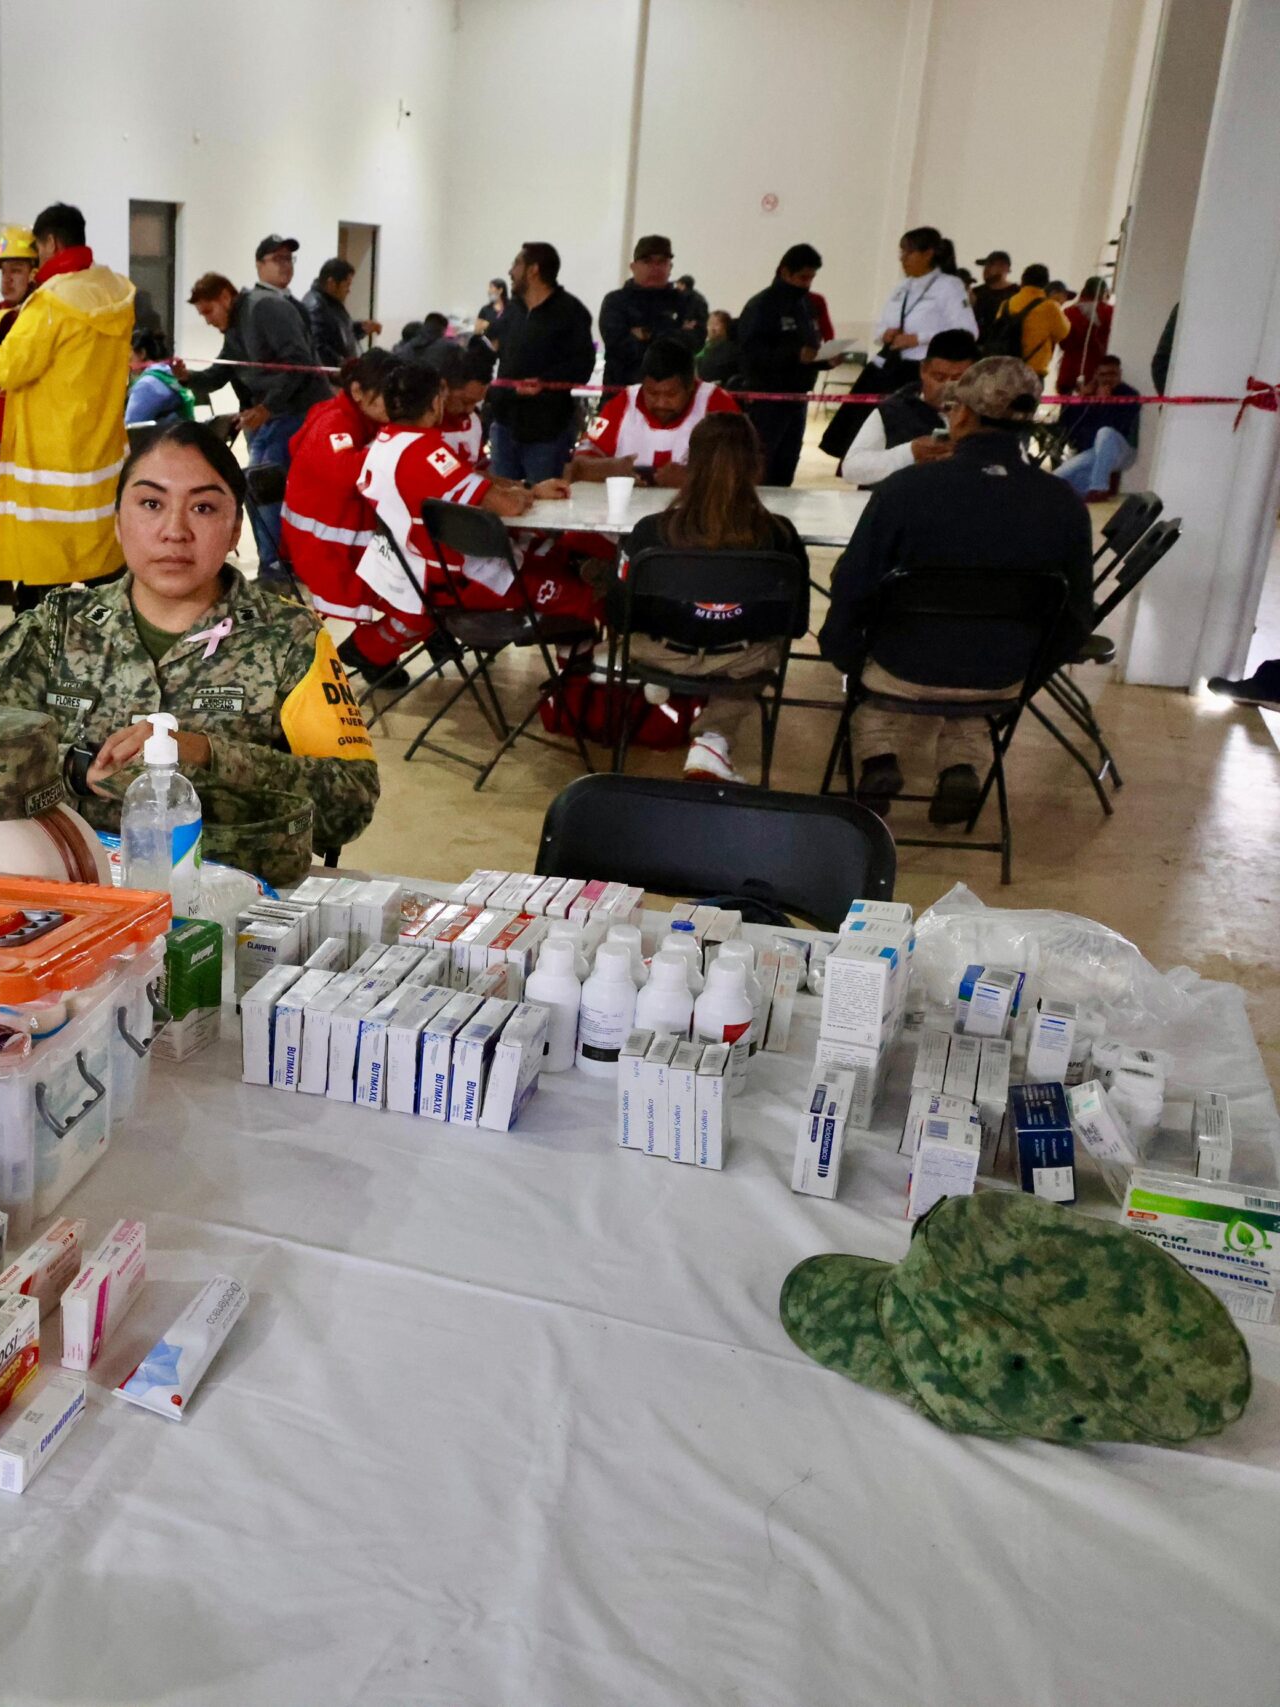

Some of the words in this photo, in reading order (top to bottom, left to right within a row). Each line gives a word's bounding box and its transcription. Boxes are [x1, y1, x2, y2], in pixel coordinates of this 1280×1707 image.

[694, 607, 743, 620] MEXICO
[55, 696, 81, 708] FLORES
[321, 682, 357, 706] DN
[247, 941, 277, 954] CLAVIPEN
[285, 1045, 297, 1087] BUTIMAXIL
[368, 1062, 381, 1103] BUTIMAXIL
[432, 1073, 445, 1115] BUTIMAXIL
[463, 1080, 477, 1122] BUTIMAXIL
[206, 1281, 241, 1326] Diclofenaco
